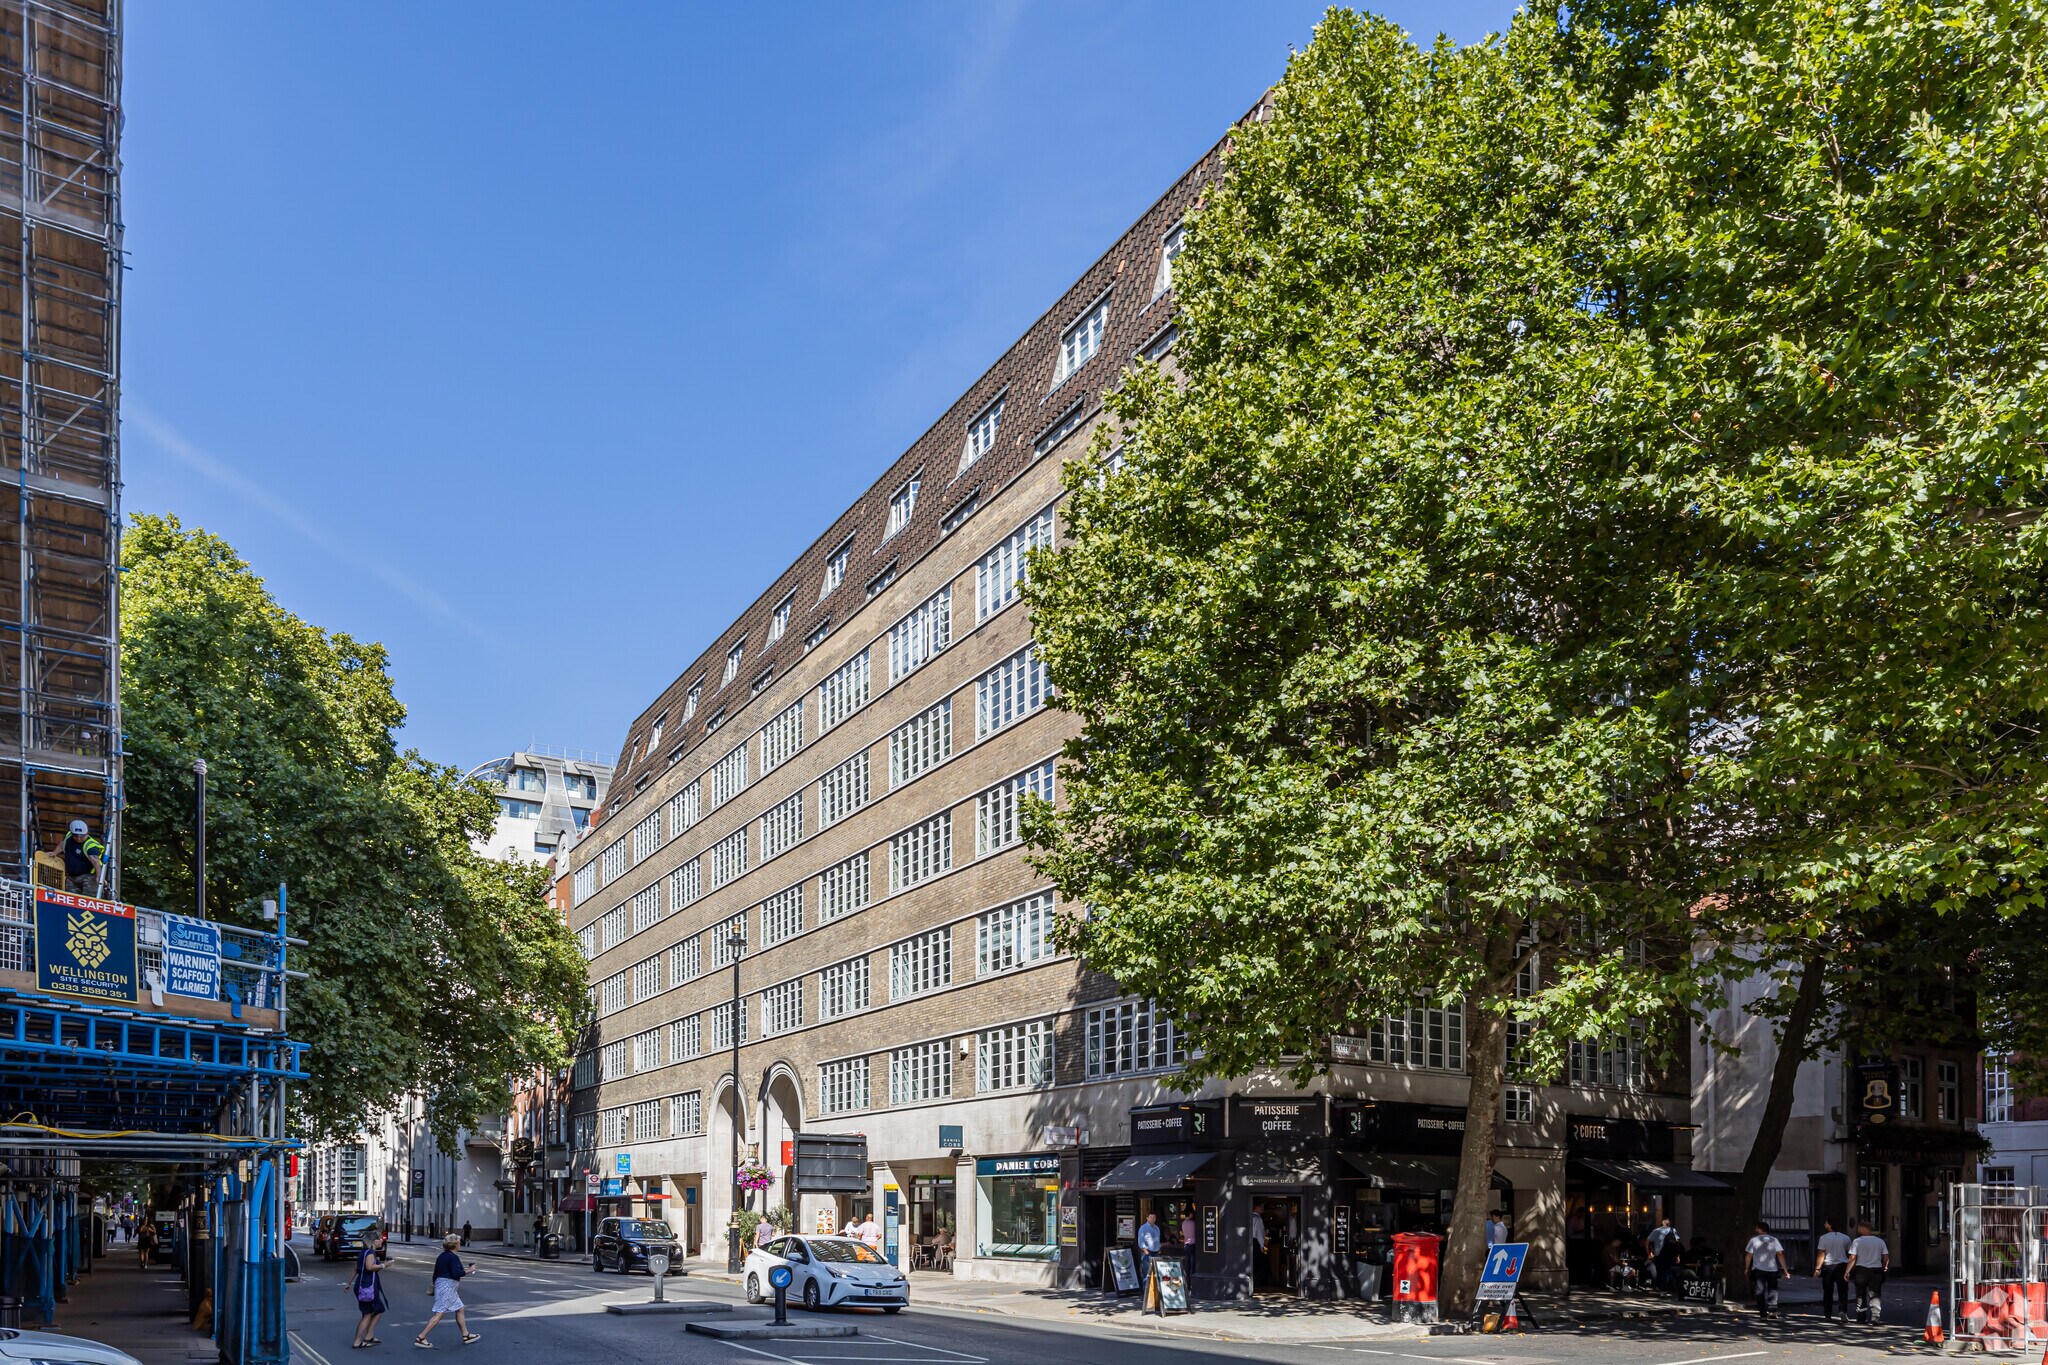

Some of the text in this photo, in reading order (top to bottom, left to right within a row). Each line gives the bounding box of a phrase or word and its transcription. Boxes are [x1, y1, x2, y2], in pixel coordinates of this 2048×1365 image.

[44, 891, 127, 915] FIRE SAFETY
[176, 923, 210, 943] SUTTIE
[169, 951, 215, 972] WARNING
[49, 963, 128, 985] WELLINGTON
[171, 967, 212, 984] SCAFFOLD
[60, 975, 120, 989] SITE SECURITY
[171, 979, 210, 995] ALARMED
[51, 982, 127, 999] 0333 3580 351
[1254, 1105, 1300, 1116] PATISSERIE
[1137, 1119, 1162, 1130] PATISSERIE
[1165, 1117, 1183, 1128] COFFEE
[1262, 1120, 1292, 1131] COFFEE
[1417, 1118, 1445, 1130] PATISSERIE
[1448, 1120, 1466, 1131] COFFEE
[1579, 1125, 1606, 1139] COFFEE
[996, 1159, 1060, 1171] DANIEL COBB
[1689, 1286, 1715, 1298] OPEN
